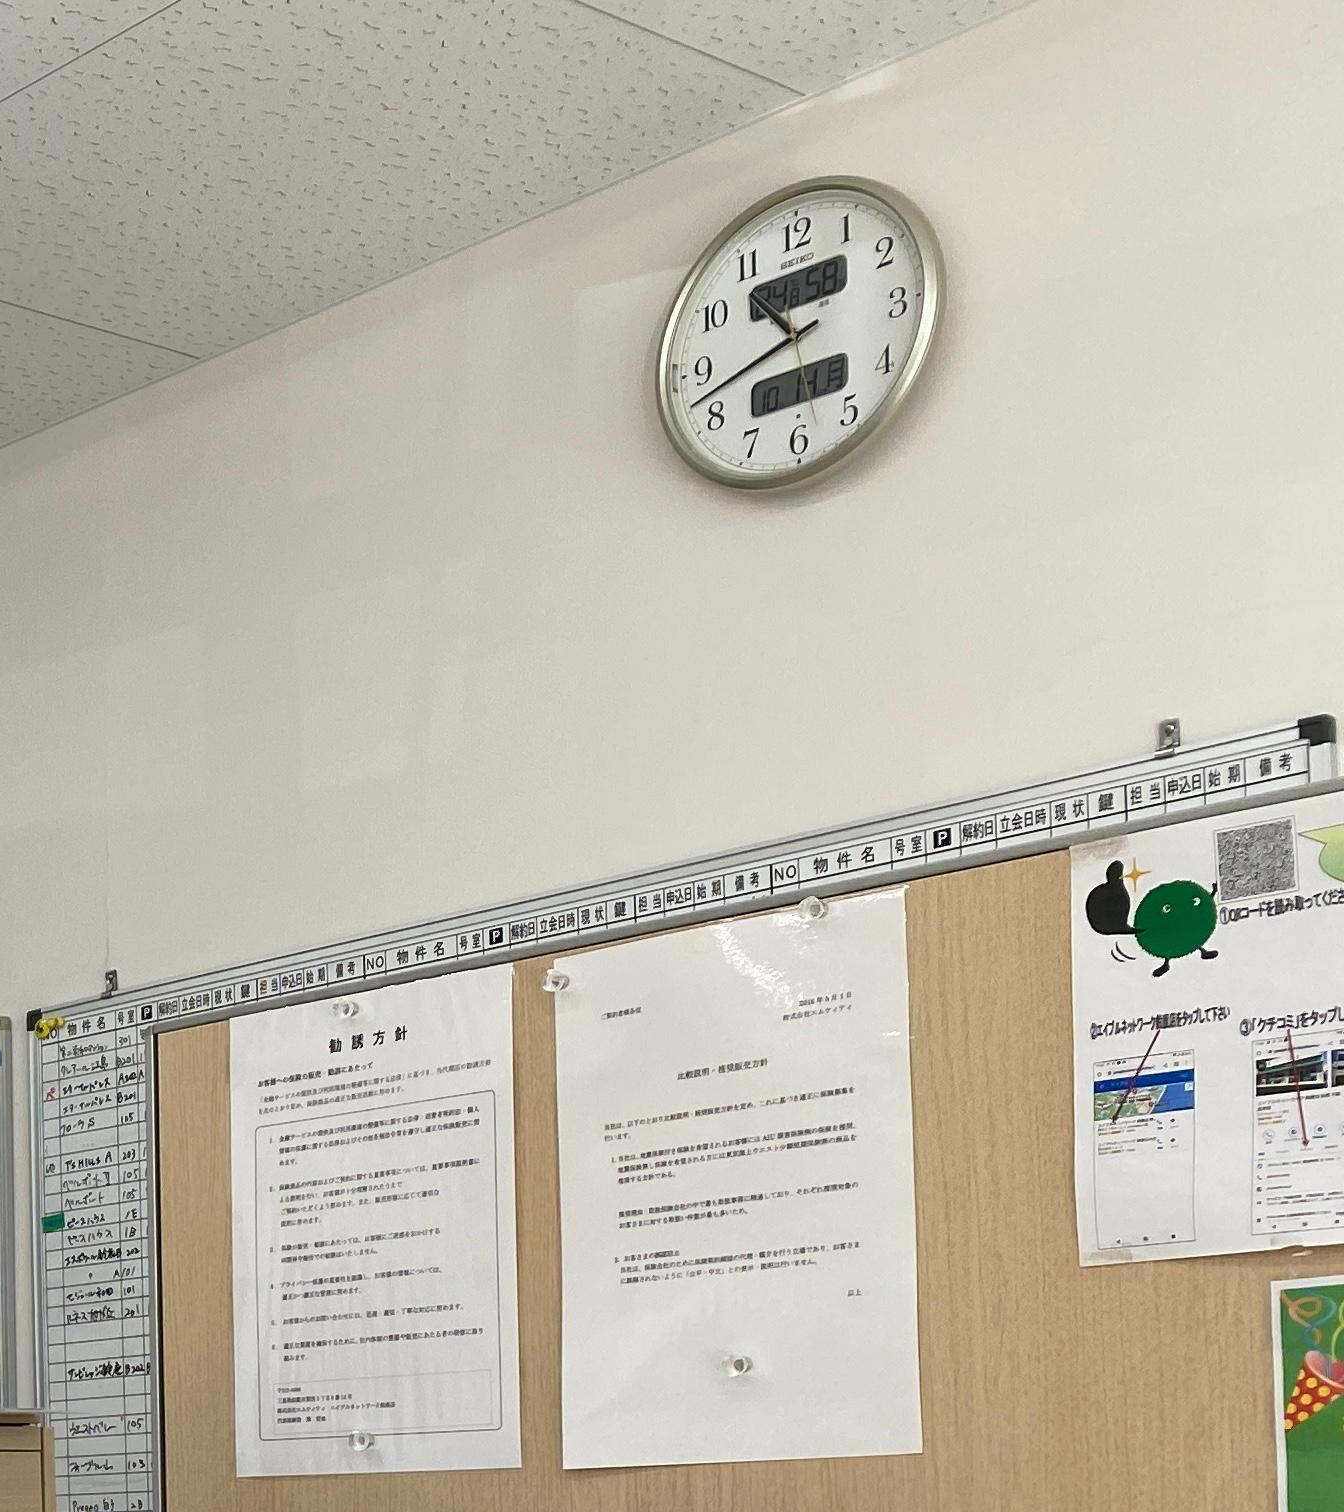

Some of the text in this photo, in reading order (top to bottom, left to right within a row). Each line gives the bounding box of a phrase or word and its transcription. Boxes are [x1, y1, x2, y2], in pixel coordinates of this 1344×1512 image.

[782, 216, 811, 253] 12
[840, 214, 850, 244] 1
[737, 249, 758, 283] 11
[780, 252, 814, 270] SEIKO
[875, 236, 894, 269] 2
[701, 299, 728, 334] 10
[889, 287, 907, 318] 3
[695, 355, 713, 386] 9
[875, 344, 894, 375] 4
[707, 400, 725, 430] 8
[840, 394, 858, 427] 5
[742, 428, 759, 459] 7
[789, 424, 808, 455] 6
[366, 955, 384, 971] NO
[396, 942, 445, 965] 物件名
[459, 933, 480, 950] 号室
[511, 921, 535, 939] 解約日
[540, 913, 575, 934] 立会日時
[581, 909, 604, 925] 現状
[638, 895, 661, 912] 担当
[666, 887, 692, 905] 申込日
[696, 881, 722, 899] 始期
[734, 872, 760, 892] 備考
[775, 865, 796, 881] NO
[814, 847, 875, 874] 物件名
[895, 836, 922, 856] 号室
[963, 820, 993, 841] 解約日
[1000, 809, 1046, 833] 立会日時
[1055, 800, 1084, 820] 現状
[1131, 783, 1160, 803] 担当
[1168, 774, 1202, 796] 申込日
[1209, 764, 1240, 787] 始期
[1260, 752, 1292, 776] 備考
[329, 1026, 408, 1053] 勧誘方針
